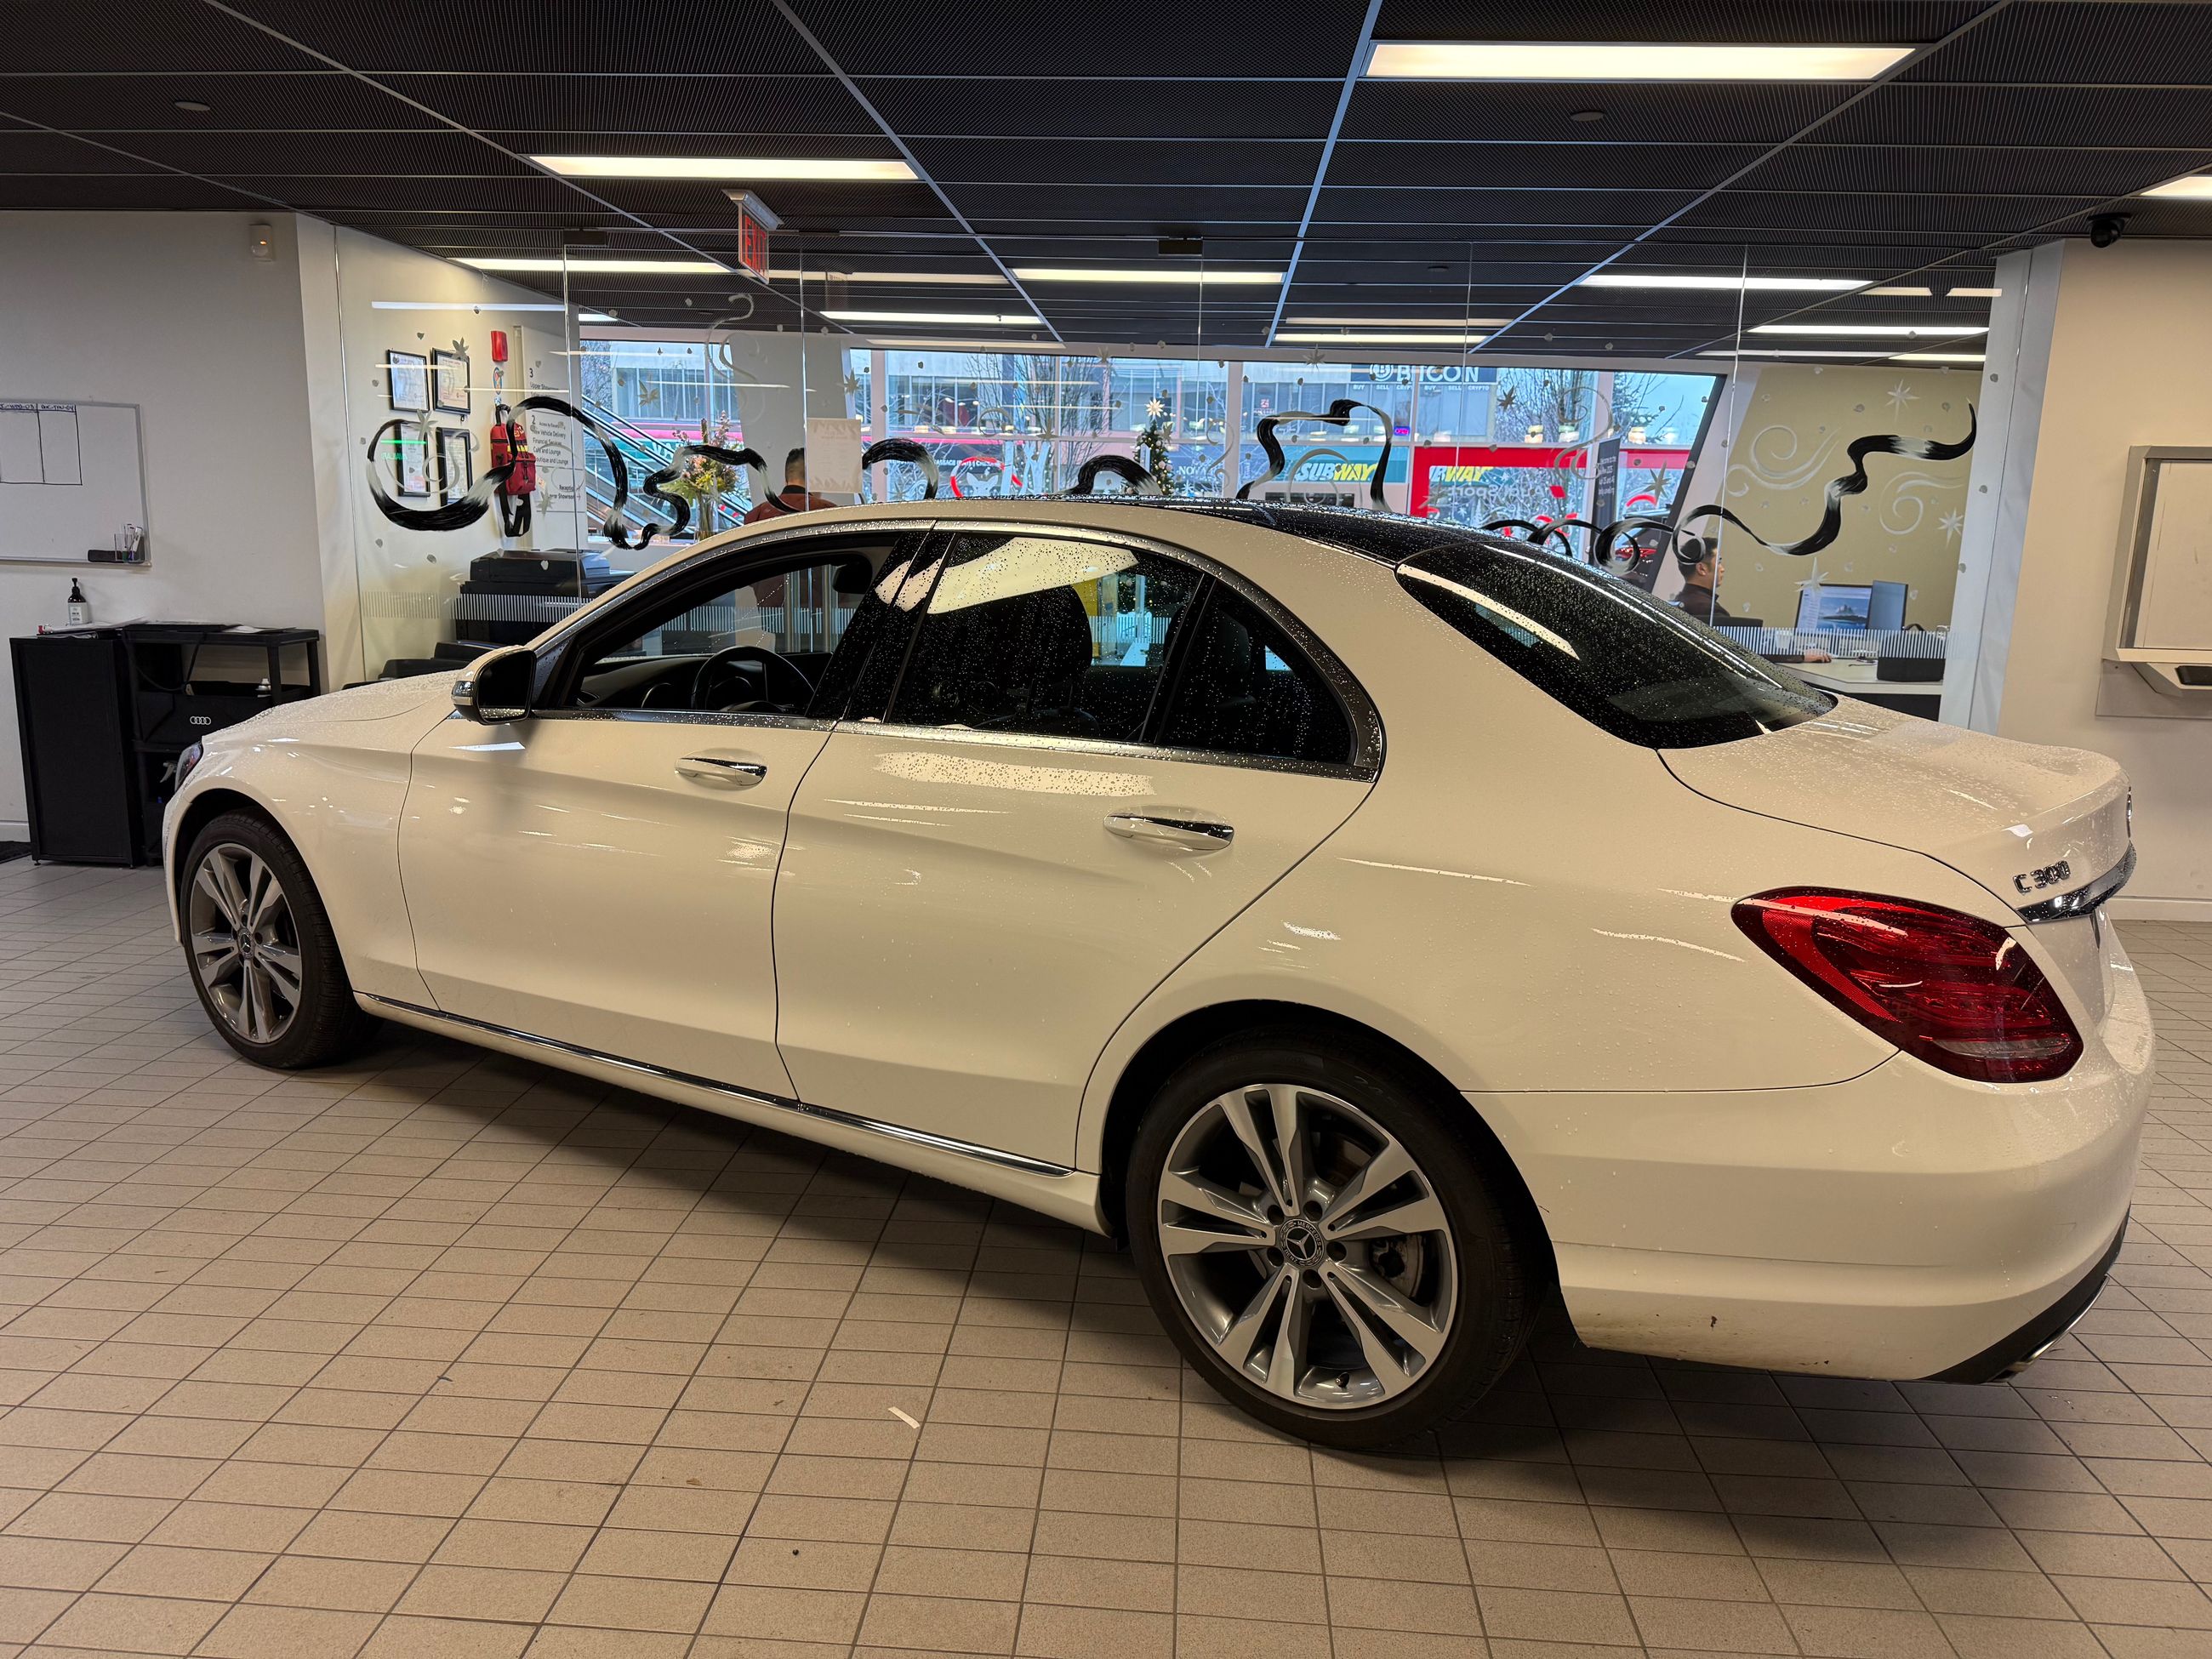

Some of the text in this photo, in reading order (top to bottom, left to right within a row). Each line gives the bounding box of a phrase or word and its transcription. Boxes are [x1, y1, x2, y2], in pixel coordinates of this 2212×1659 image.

[744, 214, 767, 276] EXIT
[529, 368, 533, 378] 3
[532, 415, 536, 425] 2
[553, 430, 566, 439] Delivery
[1294, 462, 1378, 481] SUBWAY
[2012, 859, 2071, 893] C 300
[1297, 1221, 1322, 1246] MERCEDES
[1284, 1249, 1298, 1263] BENZ
